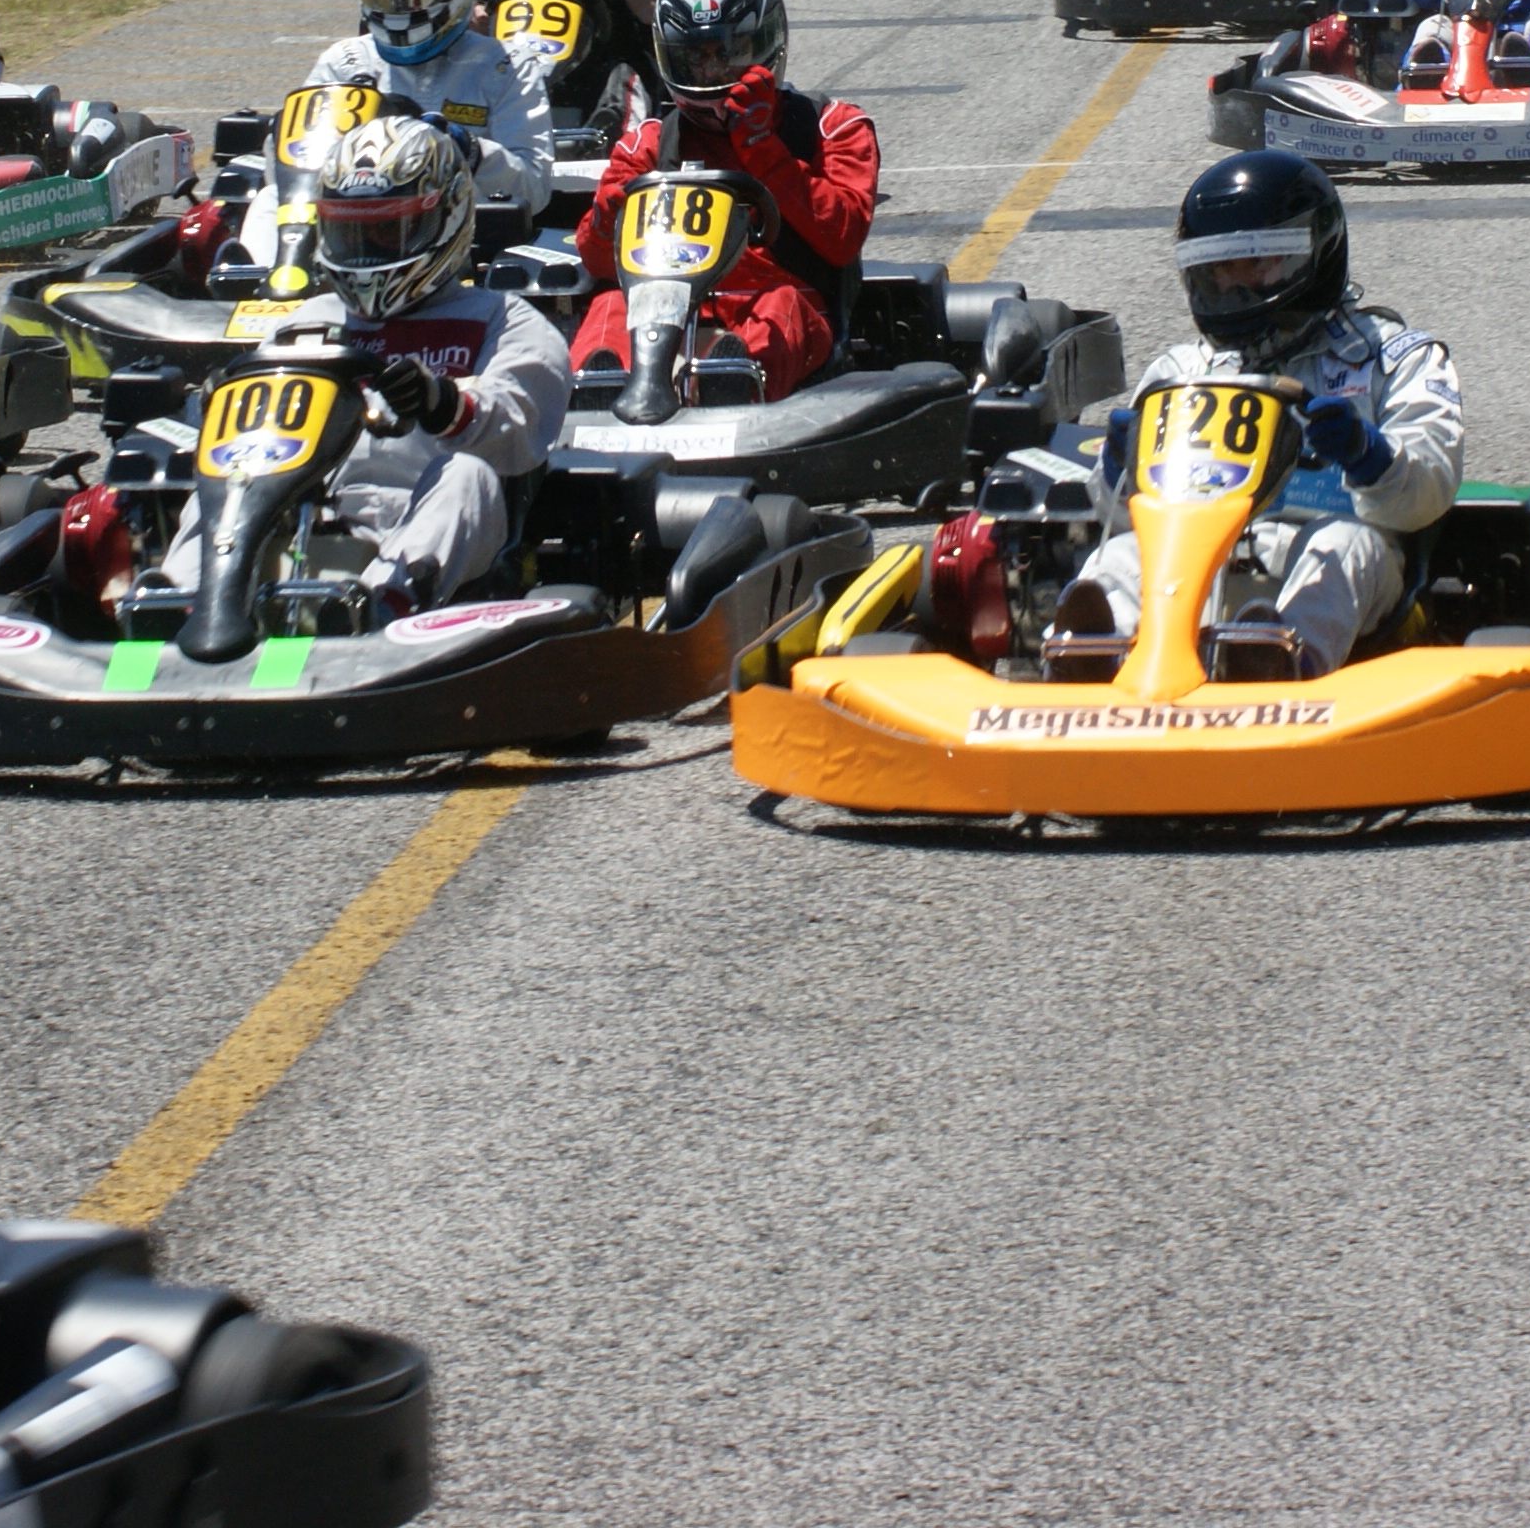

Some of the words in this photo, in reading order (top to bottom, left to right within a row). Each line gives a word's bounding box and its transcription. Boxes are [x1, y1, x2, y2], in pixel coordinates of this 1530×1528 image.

[504, 1, 571, 38] 99
[694, 8, 719, 21] agv
[287, 88, 366, 138] 103
[1310, 121, 1364, 141] climacer
[1412, 127, 1476, 144] climacer
[1295, 137, 1346, 158] climacer
[1392, 147, 1454, 162] climacer
[341, 172, 389, 189] Airoh
[636, 187, 714, 240] 148
[215, 378, 314, 441] 100
[1153, 390, 1263, 456] 128
[641, 435, 731, 455] Bayer
